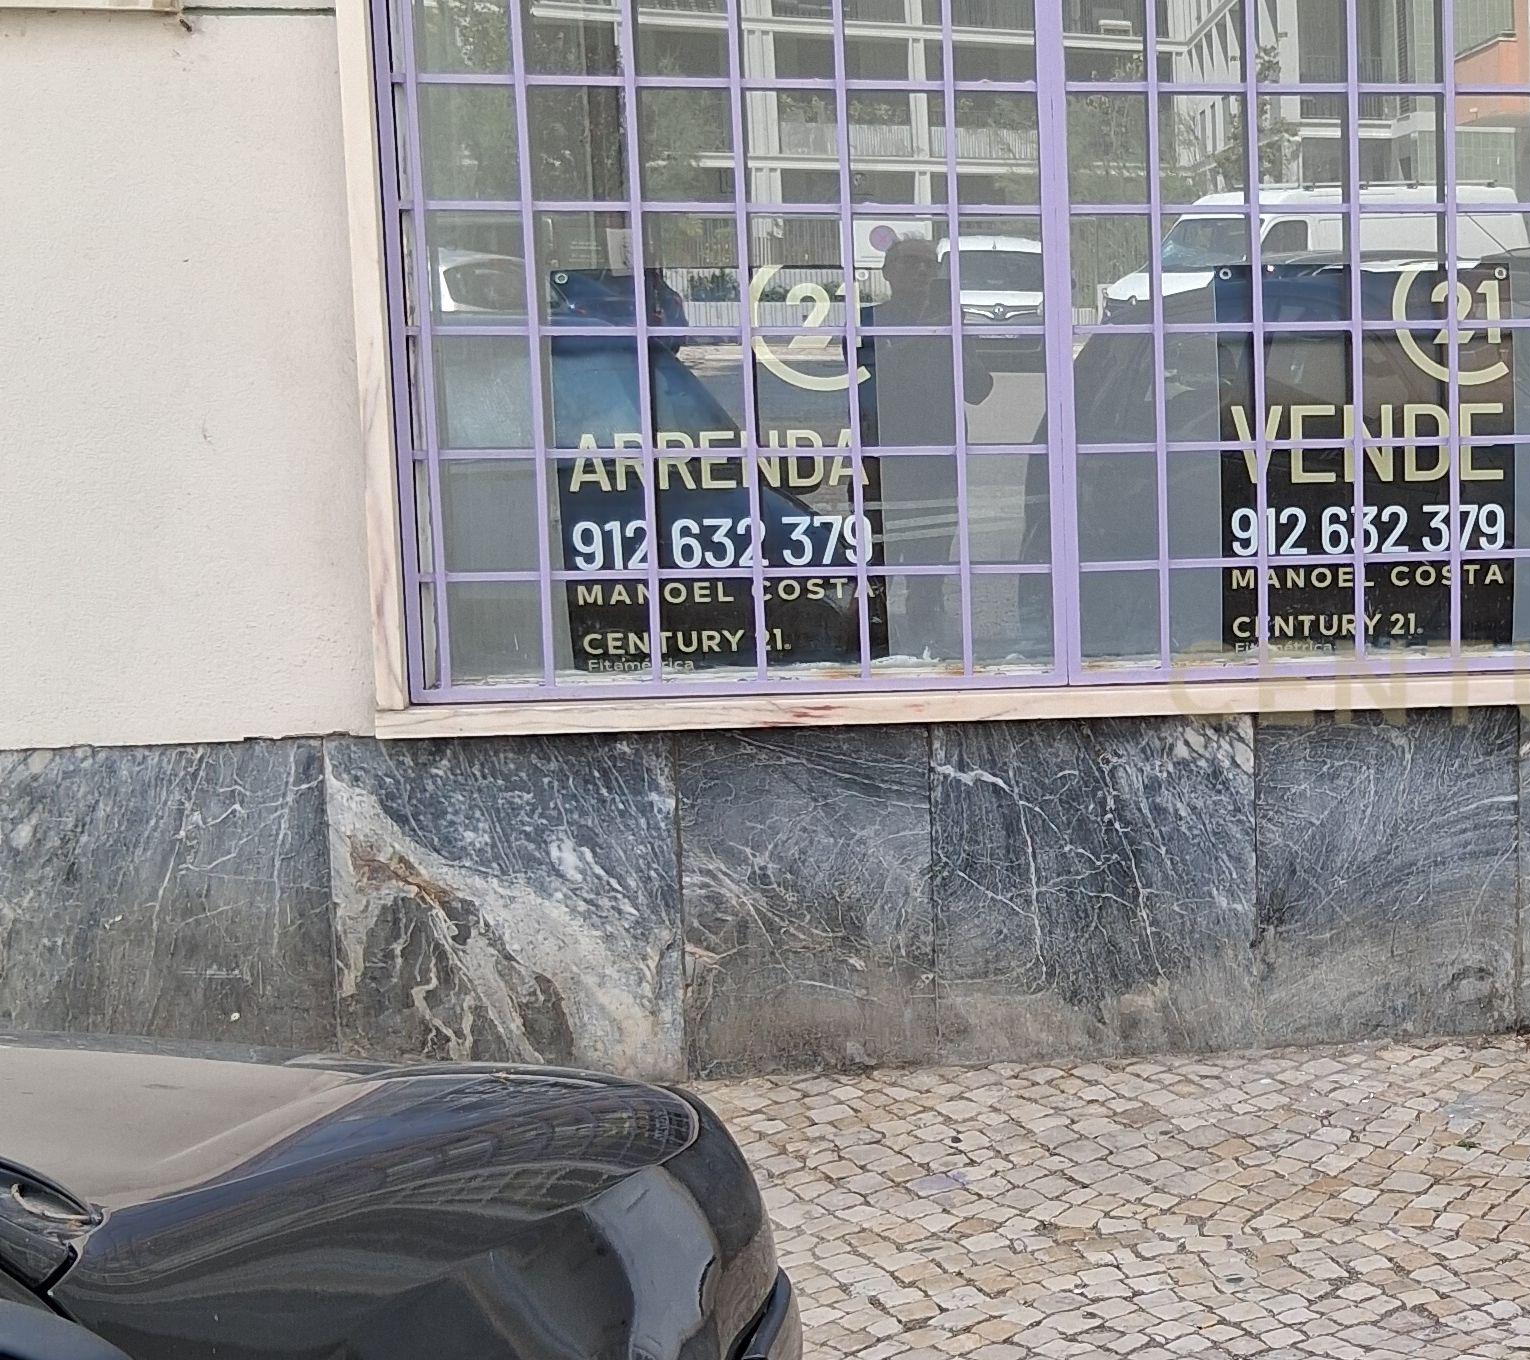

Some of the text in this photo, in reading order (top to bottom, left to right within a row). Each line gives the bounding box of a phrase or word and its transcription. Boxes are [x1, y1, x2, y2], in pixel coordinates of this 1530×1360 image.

[569, 429, 870, 492] ARRENDA
[1231, 403, 1504, 484] VENDE
[572, 515, 873, 571] 912 632 379
[1231, 504, 1505, 557] 912 632 379
[576, 581, 735, 606] MANOEL
[1390, 564, 1504, 587] COSTA
[583, 629, 745, 655] CENTURY
